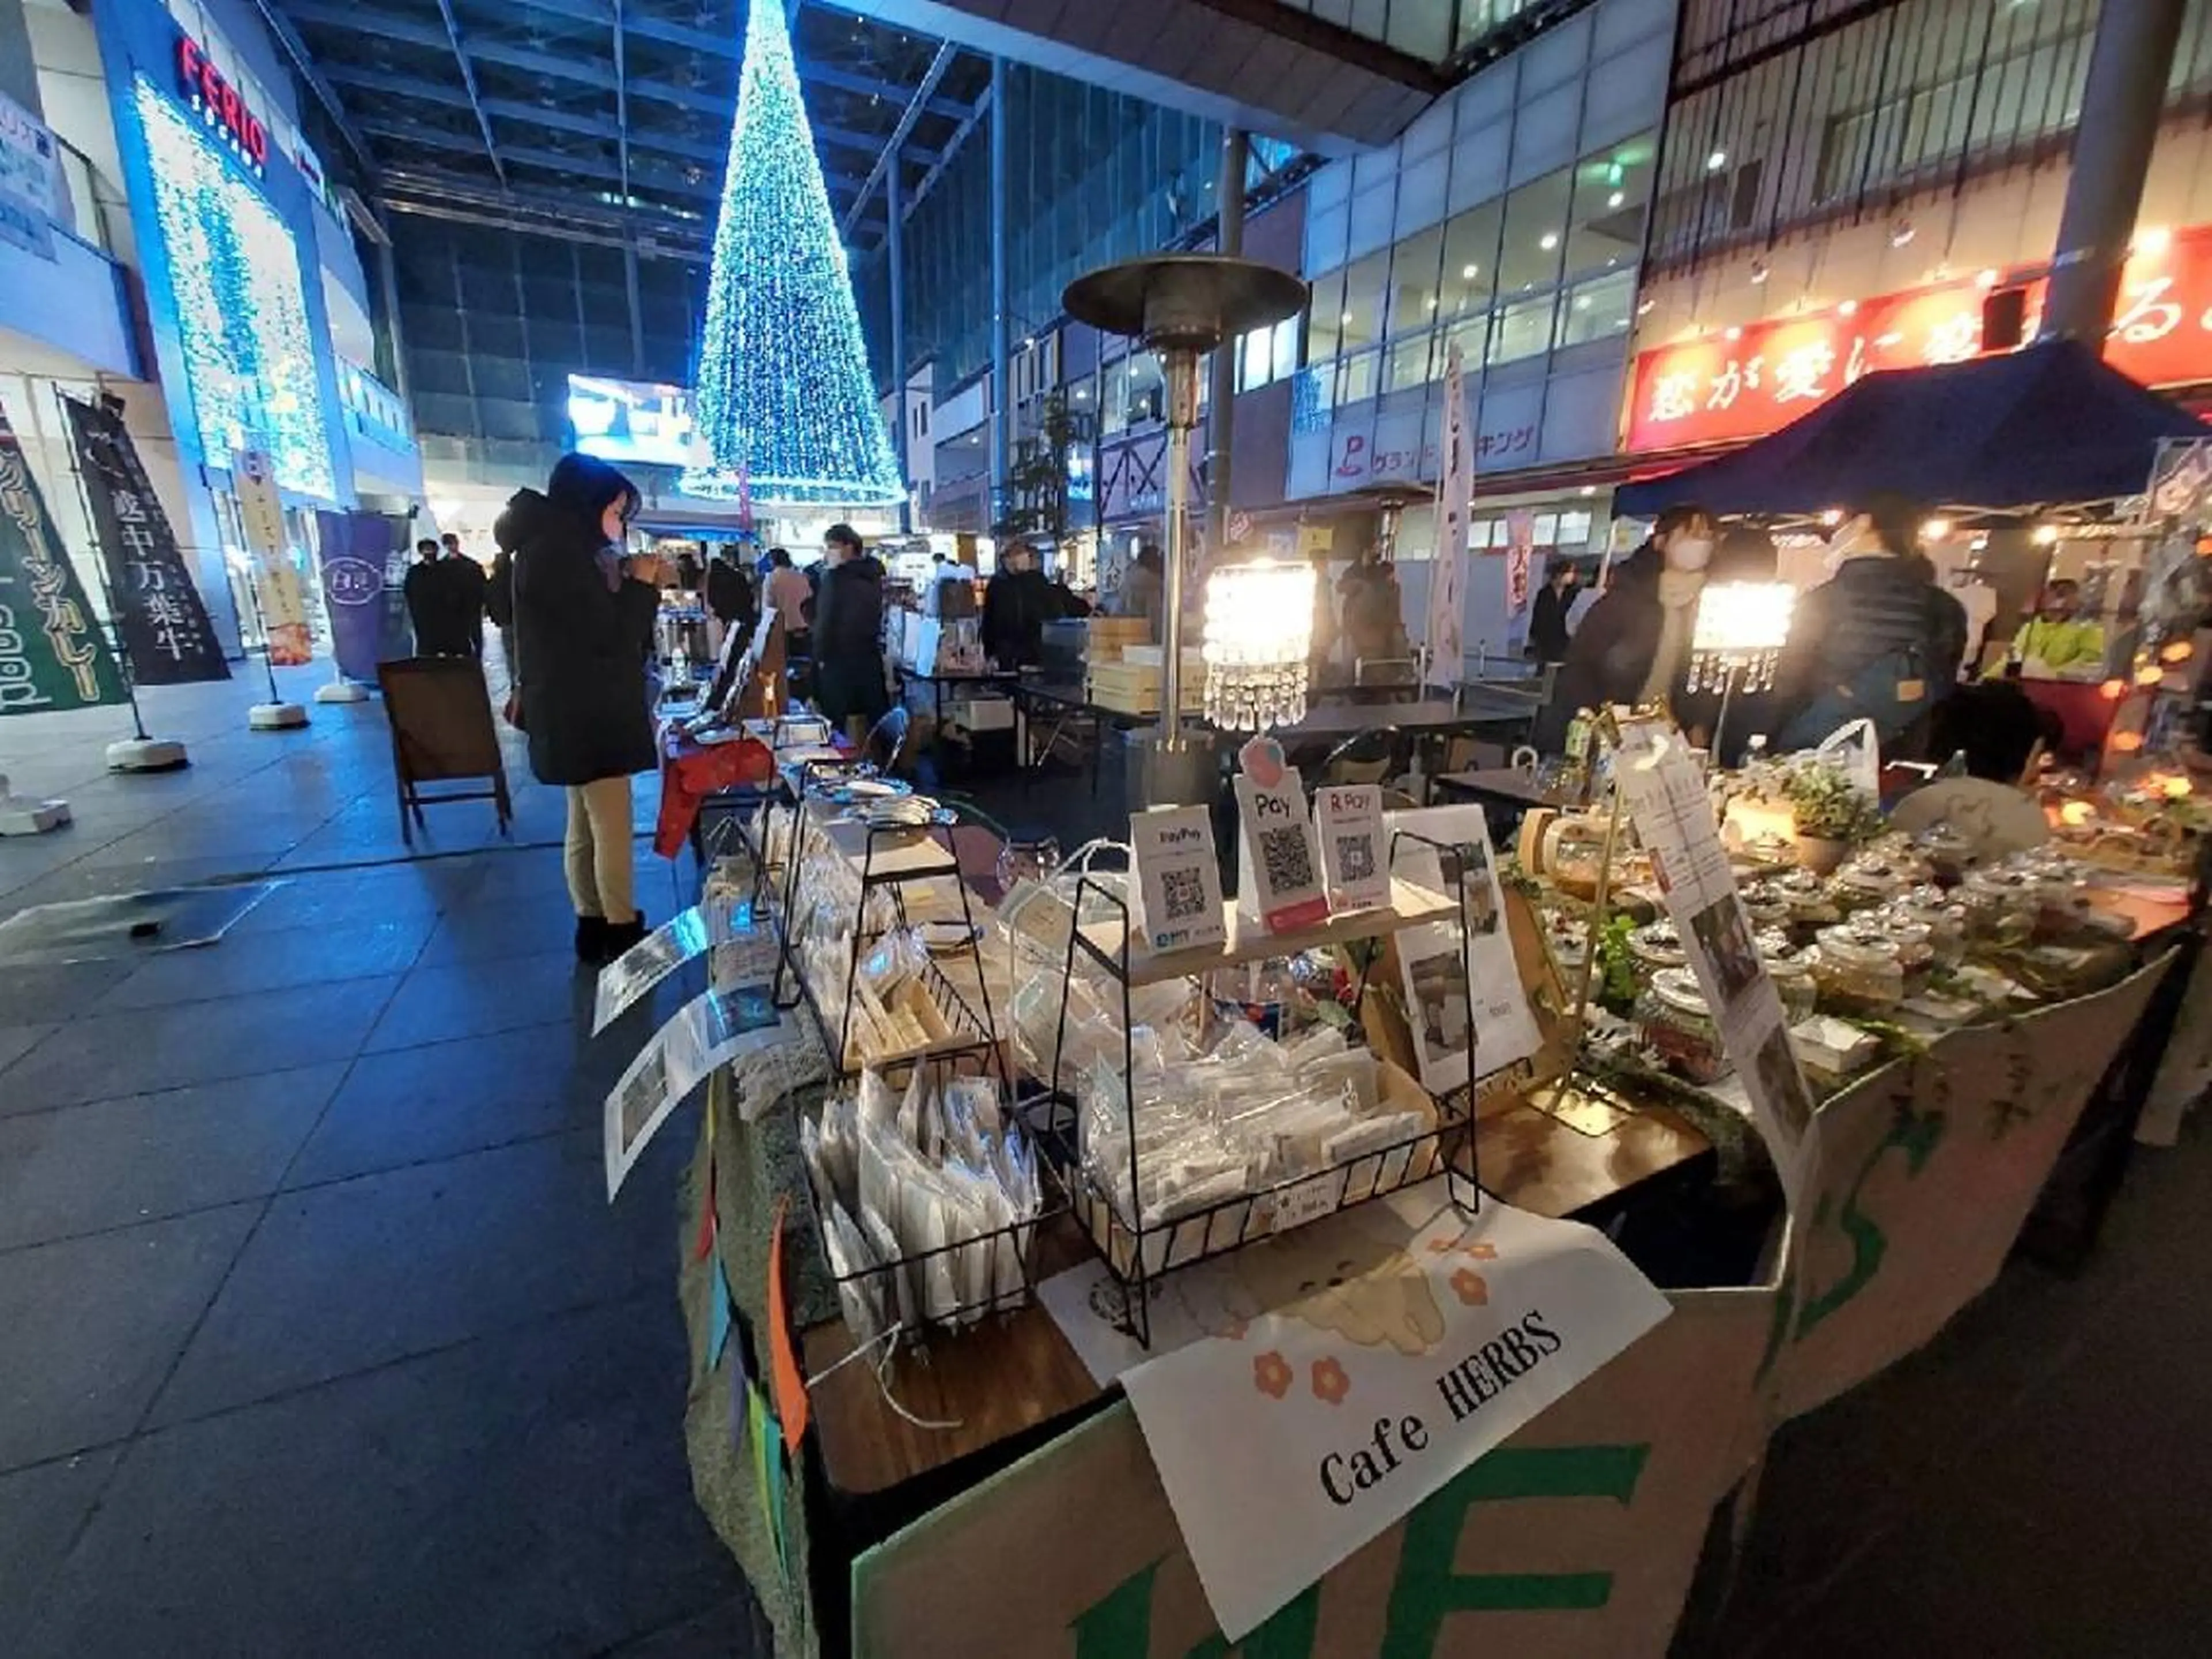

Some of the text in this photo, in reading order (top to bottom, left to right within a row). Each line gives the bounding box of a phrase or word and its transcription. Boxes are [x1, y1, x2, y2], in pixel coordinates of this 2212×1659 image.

[178, 36, 267, 166] FERIO
[1320, 1309, 1562, 1506] Cafe HERBS
